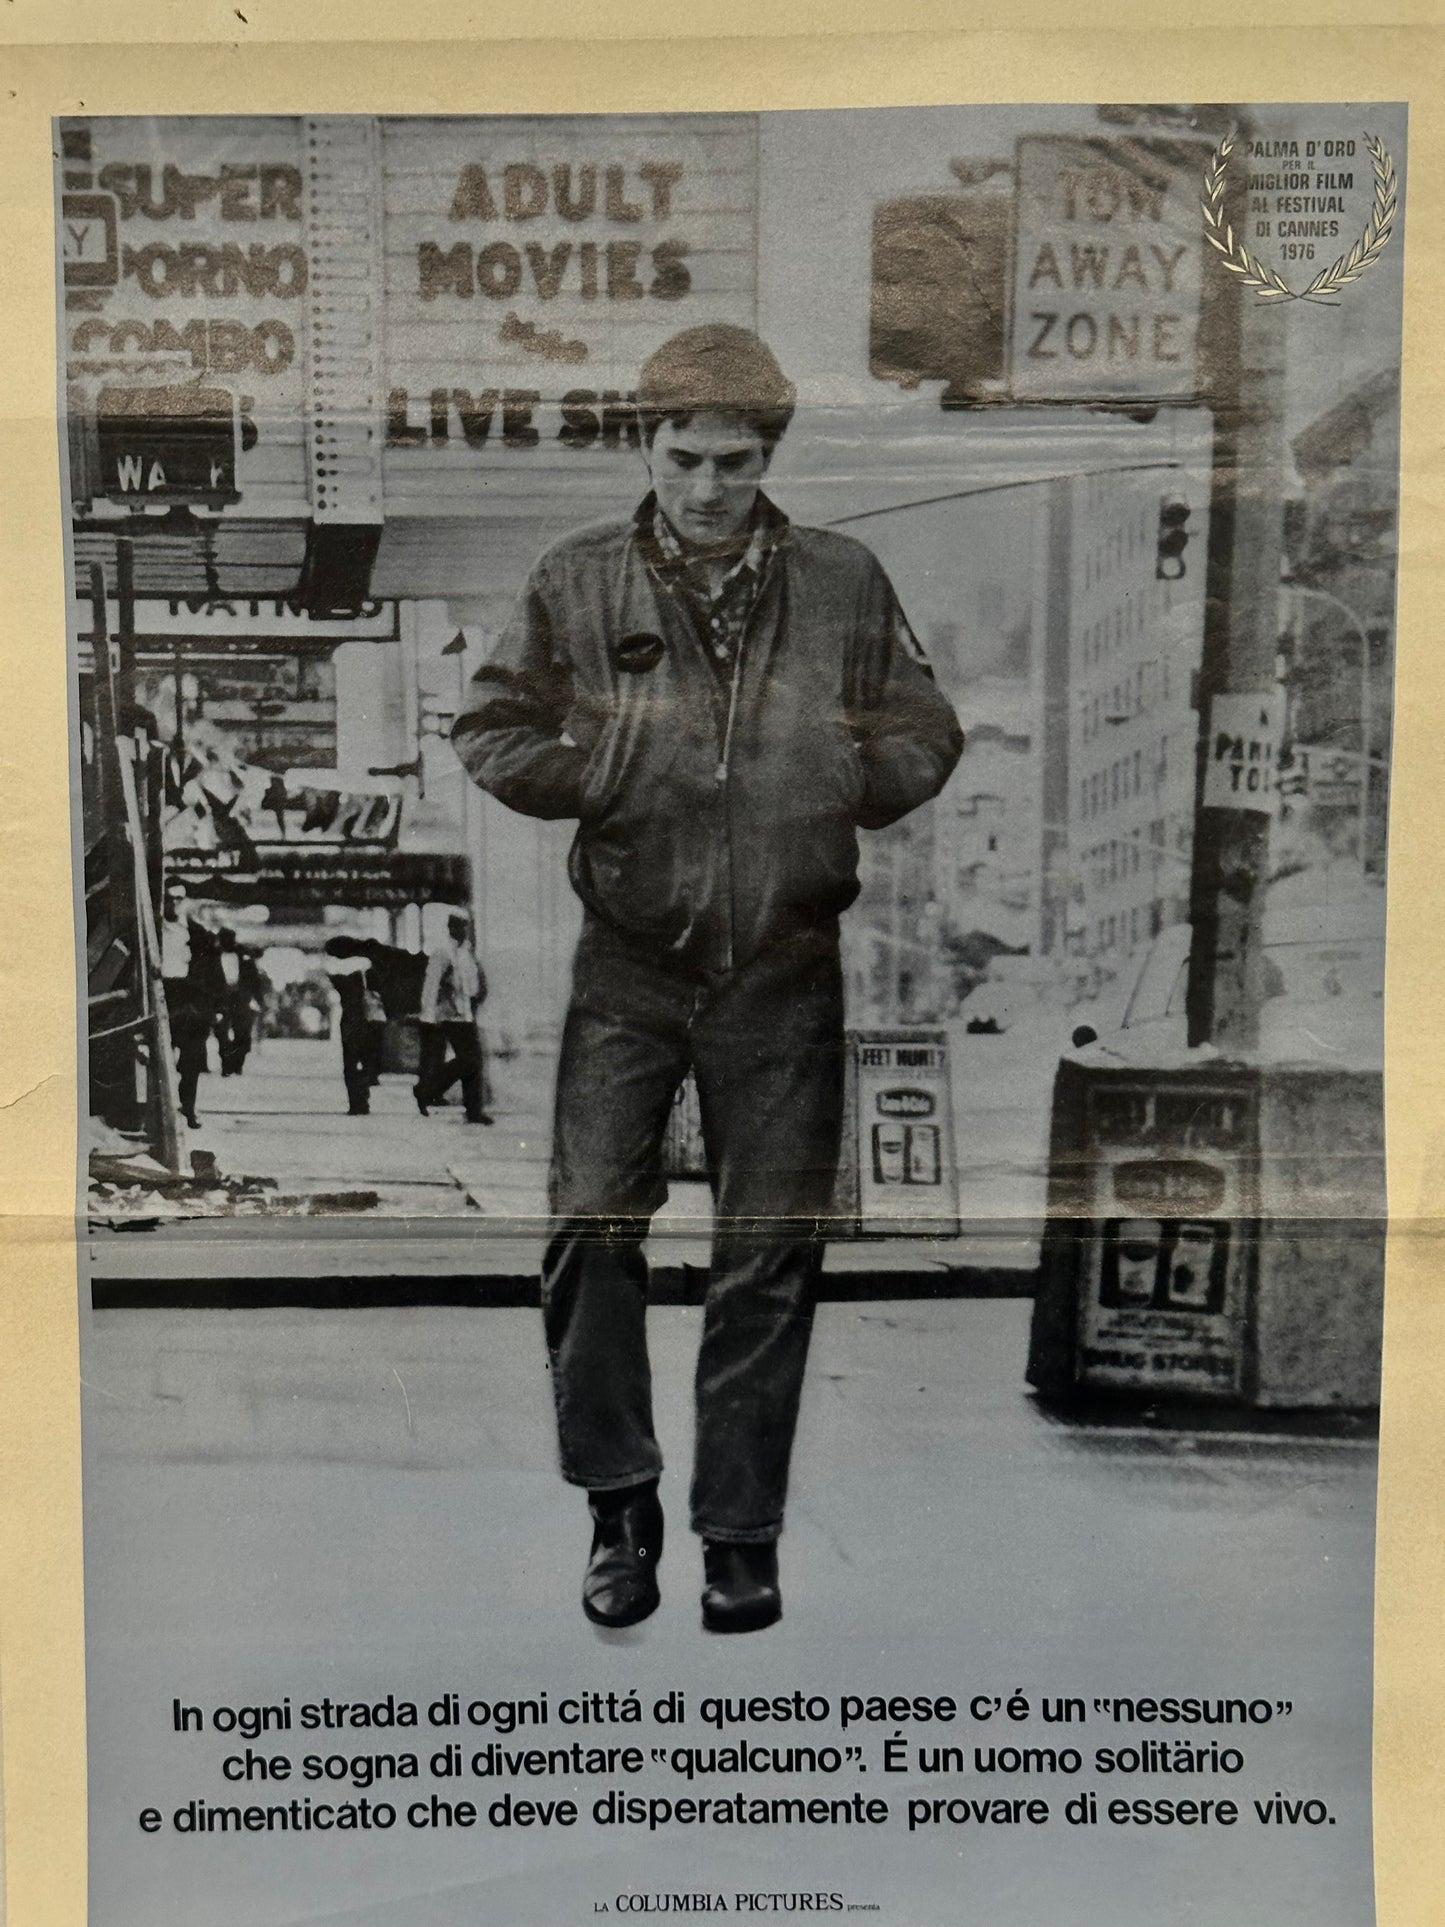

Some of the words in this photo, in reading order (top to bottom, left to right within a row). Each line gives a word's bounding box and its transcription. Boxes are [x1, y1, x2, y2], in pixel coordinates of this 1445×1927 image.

[1245, 140, 1298, 159] PALMA
[1306, 139, 1356, 158] D'ORO
[1282, 160, 1301, 171] PER
[1307, 160, 1315, 170] IL
[448, 162, 684, 223] ADULT
[1246, 174, 1310, 191] MIGLIOR
[1317, 173, 1353, 190] FILM
[1252, 197, 1269, 214] AL
[1277, 196, 1345, 214] FESTIVAL
[1256, 221, 1270, 238] DI
[1278, 220, 1339, 238] CANNES
[416, 240, 692, 301] MOVIES
[1028, 242, 1187, 292] AWAY
[1281, 243, 1315, 261] 1976
[1026, 311, 1183, 362] ZONE
[385, 387, 541, 449] LIVE
[173, 1698, 204, 1732] In
[212, 1697, 292, 1739] ogni
[300, 1695, 418, 1729] strada
[428, 1693, 460, 1726] di
[467, 1691, 548, 1734] ogni
[653, 1691, 685, 1724] di
[700, 1691, 830, 1729] questo
[840, 1695, 957, 1728] paese
[1042, 1697, 1086, 1723] un
[222, 1748, 292, 1781] che
[302, 1752, 418, 1788] sogna
[429, 1744, 462, 1777] di
[471, 1742, 644, 1777] diventare
[883, 1730, 908, 1773] É
[918, 1747, 964, 1773] un
[974, 1747, 1082, 1774] uomo
[139, 1807, 162, 1832] e
[407, 1794, 477, 1828] che
[488, 1793, 578, 1826] deve
[592, 1791, 889, 1830] disperatamente
[908, 1798, 1050, 1831] provare
[1064, 1792, 1098, 1825] di
[1107, 1798, 1239, 1825] essere
[1253, 1791, 1336, 1825] vivo.
[594, 1902, 609, 1912] LA
[616, 1894, 729, 1912] COLUMBIA
[735, 1893, 844, 1911] PICTURES
